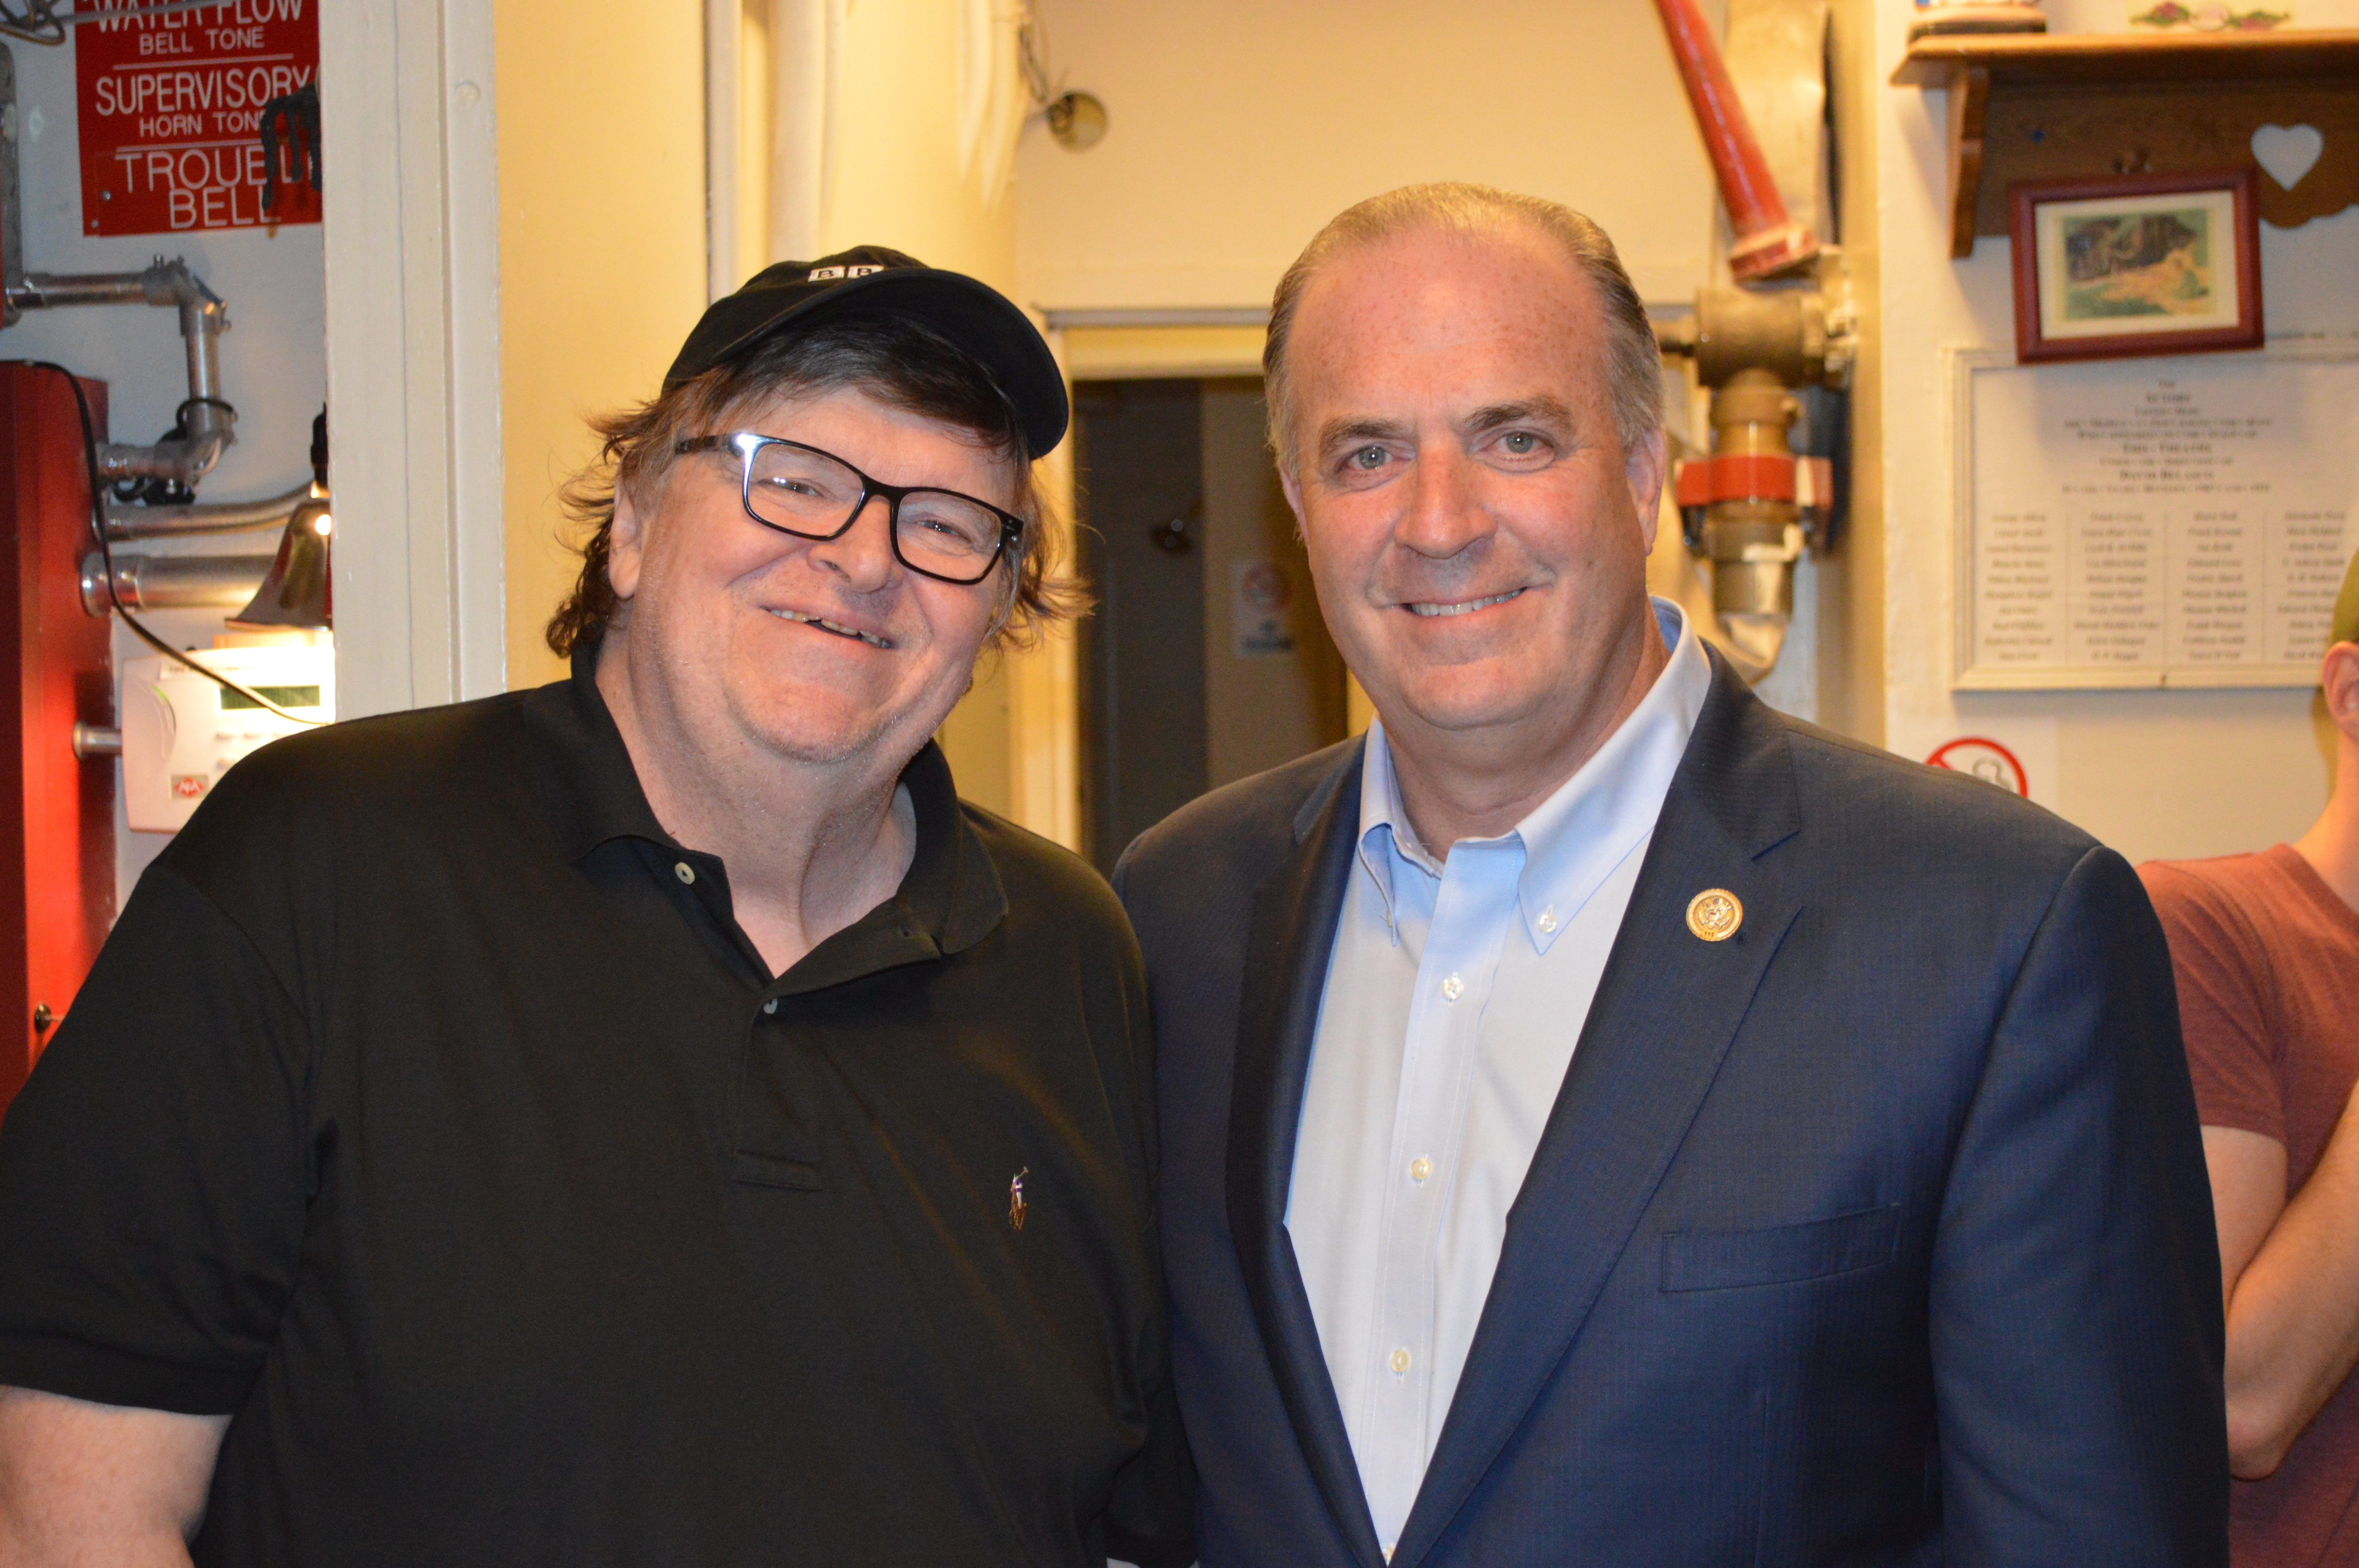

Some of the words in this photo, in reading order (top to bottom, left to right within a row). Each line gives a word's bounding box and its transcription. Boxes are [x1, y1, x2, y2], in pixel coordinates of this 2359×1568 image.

[140, 31, 194, 55] BELL
[204, 25, 265, 51] TONE
[96, 65, 311, 116] SUPERVISORY
[139, 114, 202, 138] HORN
[213, 108, 266, 133] TON
[115, 145, 313, 193] TROUBL
[169, 184, 282, 229] BELL
